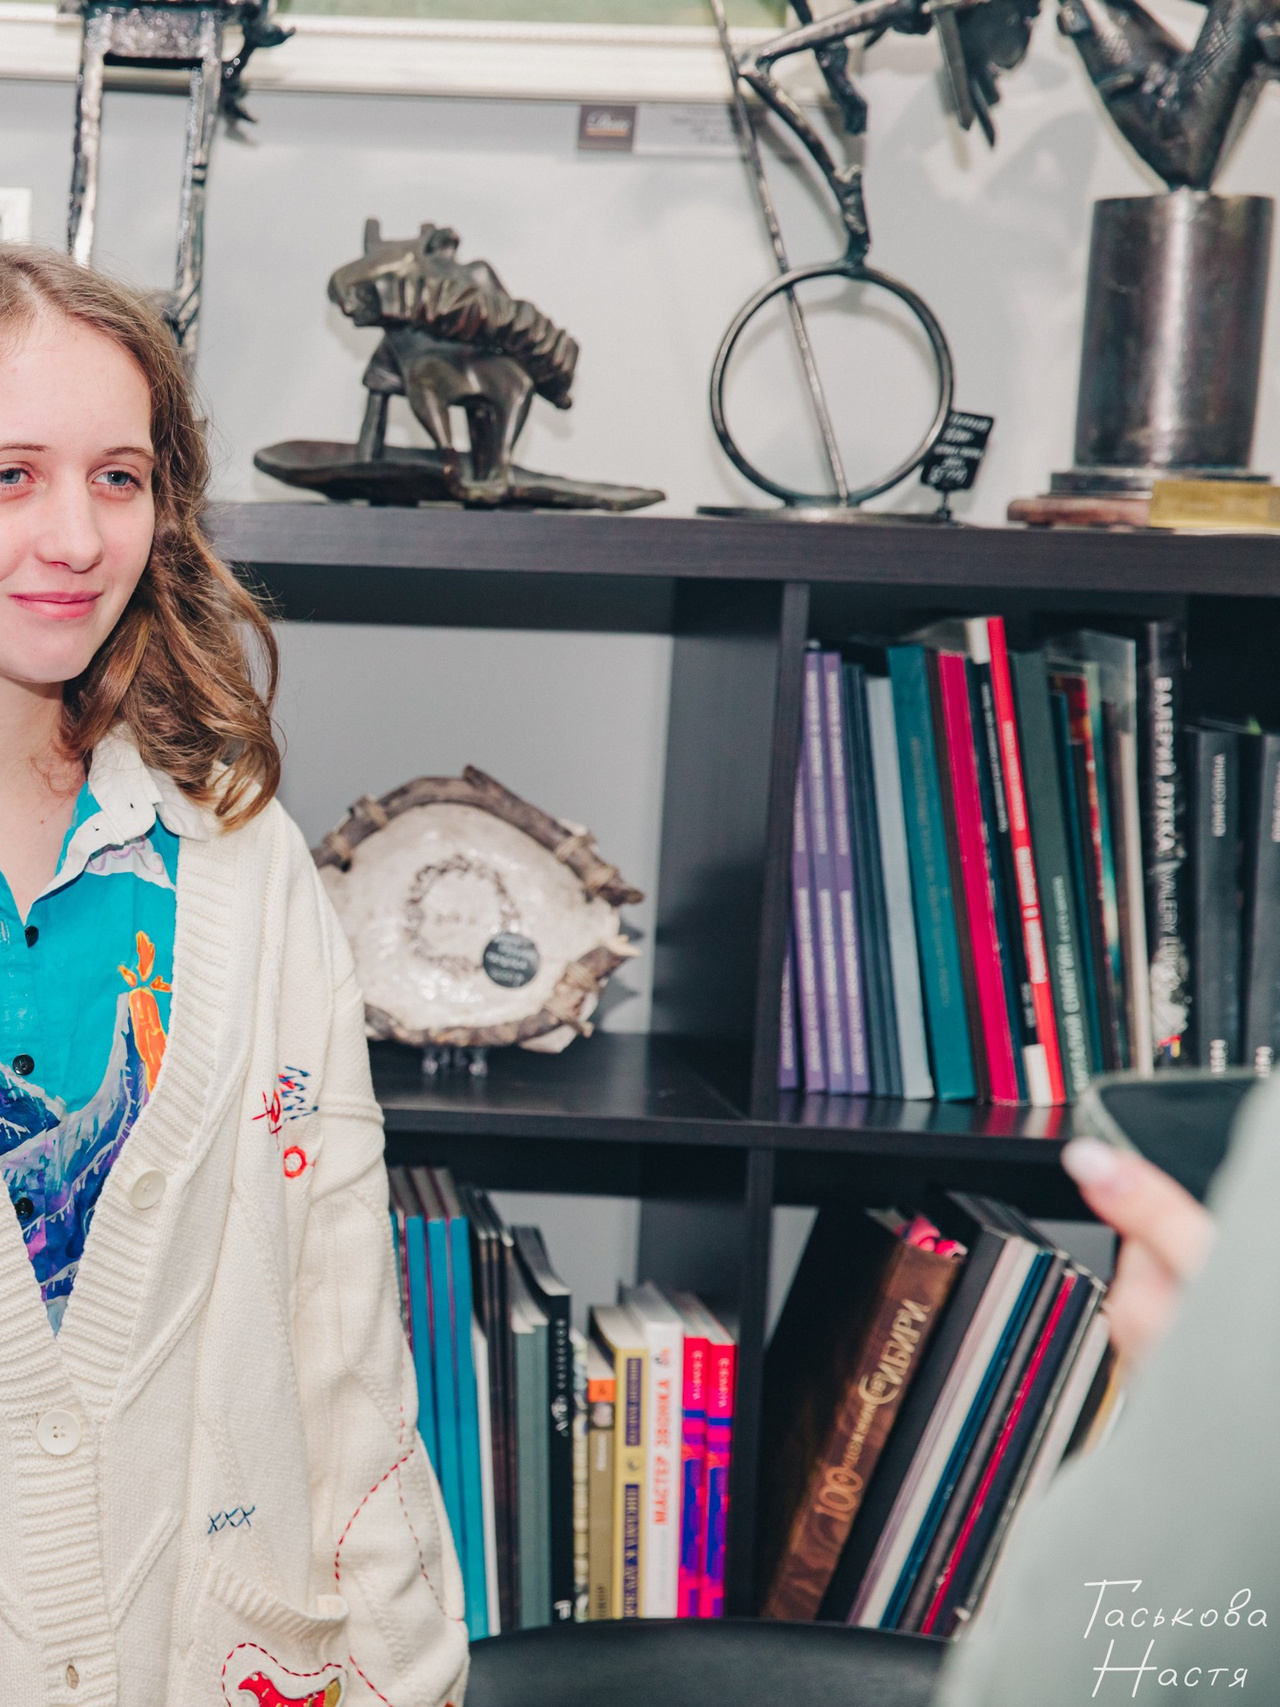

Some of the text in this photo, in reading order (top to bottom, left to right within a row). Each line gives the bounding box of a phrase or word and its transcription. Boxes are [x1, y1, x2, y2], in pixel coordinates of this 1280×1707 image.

[1154, 677, 1177, 854] ВАЛЕРИЙ ЛУККА
[654, 1456, 671, 1525] МАСТЕР
[815, 1467, 864, 1521] 100
